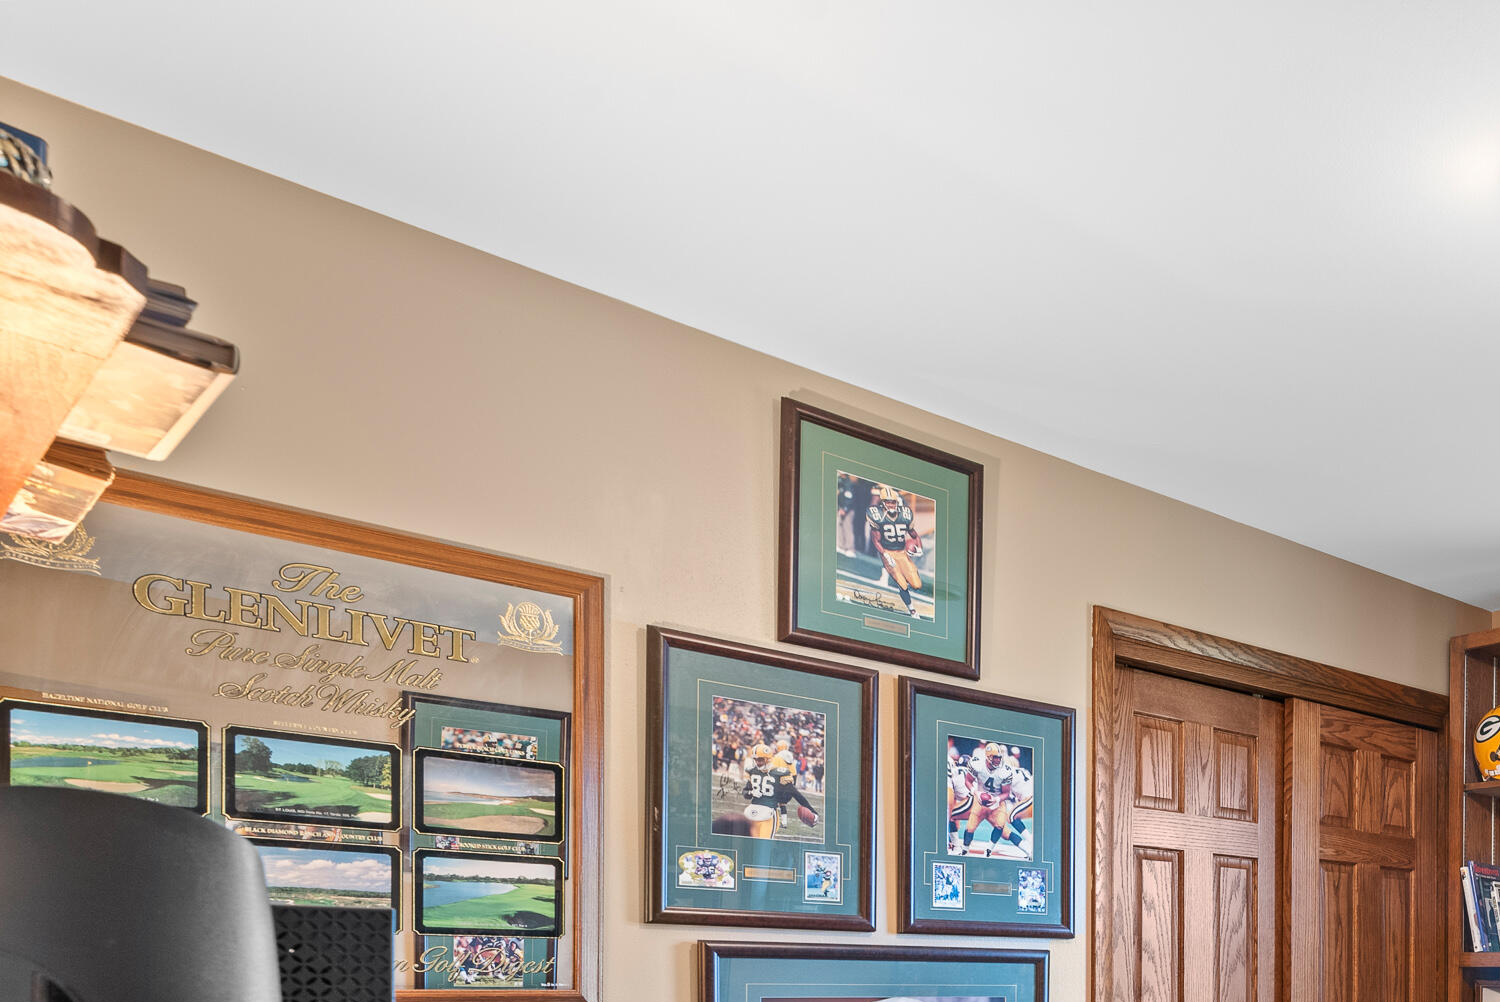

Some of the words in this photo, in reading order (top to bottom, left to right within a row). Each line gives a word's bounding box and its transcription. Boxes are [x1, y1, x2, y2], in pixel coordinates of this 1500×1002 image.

[883, 524, 907, 542] 25
[271, 562, 365, 602] The
[132, 573, 477, 664] GLENLIVET
[184, 628, 270, 667] Pure
[273, 644, 367, 684] Single
[366, 658, 444, 691] Malt
[86, 697, 124, 708] NATIONAL
[214, 673, 314, 709] Scotch
[314, 683, 418, 729] Whisky
[750, 774, 775, 798] 86
[984, 777, 995, 792] 4
[244, 826, 267, 834] BLACK
[267, 828, 298, 836] DIAMOND
[341, 834, 365, 842] OUNTRY
[413, 945, 470, 982] Golf
[469, 946, 556, 982] Digest
